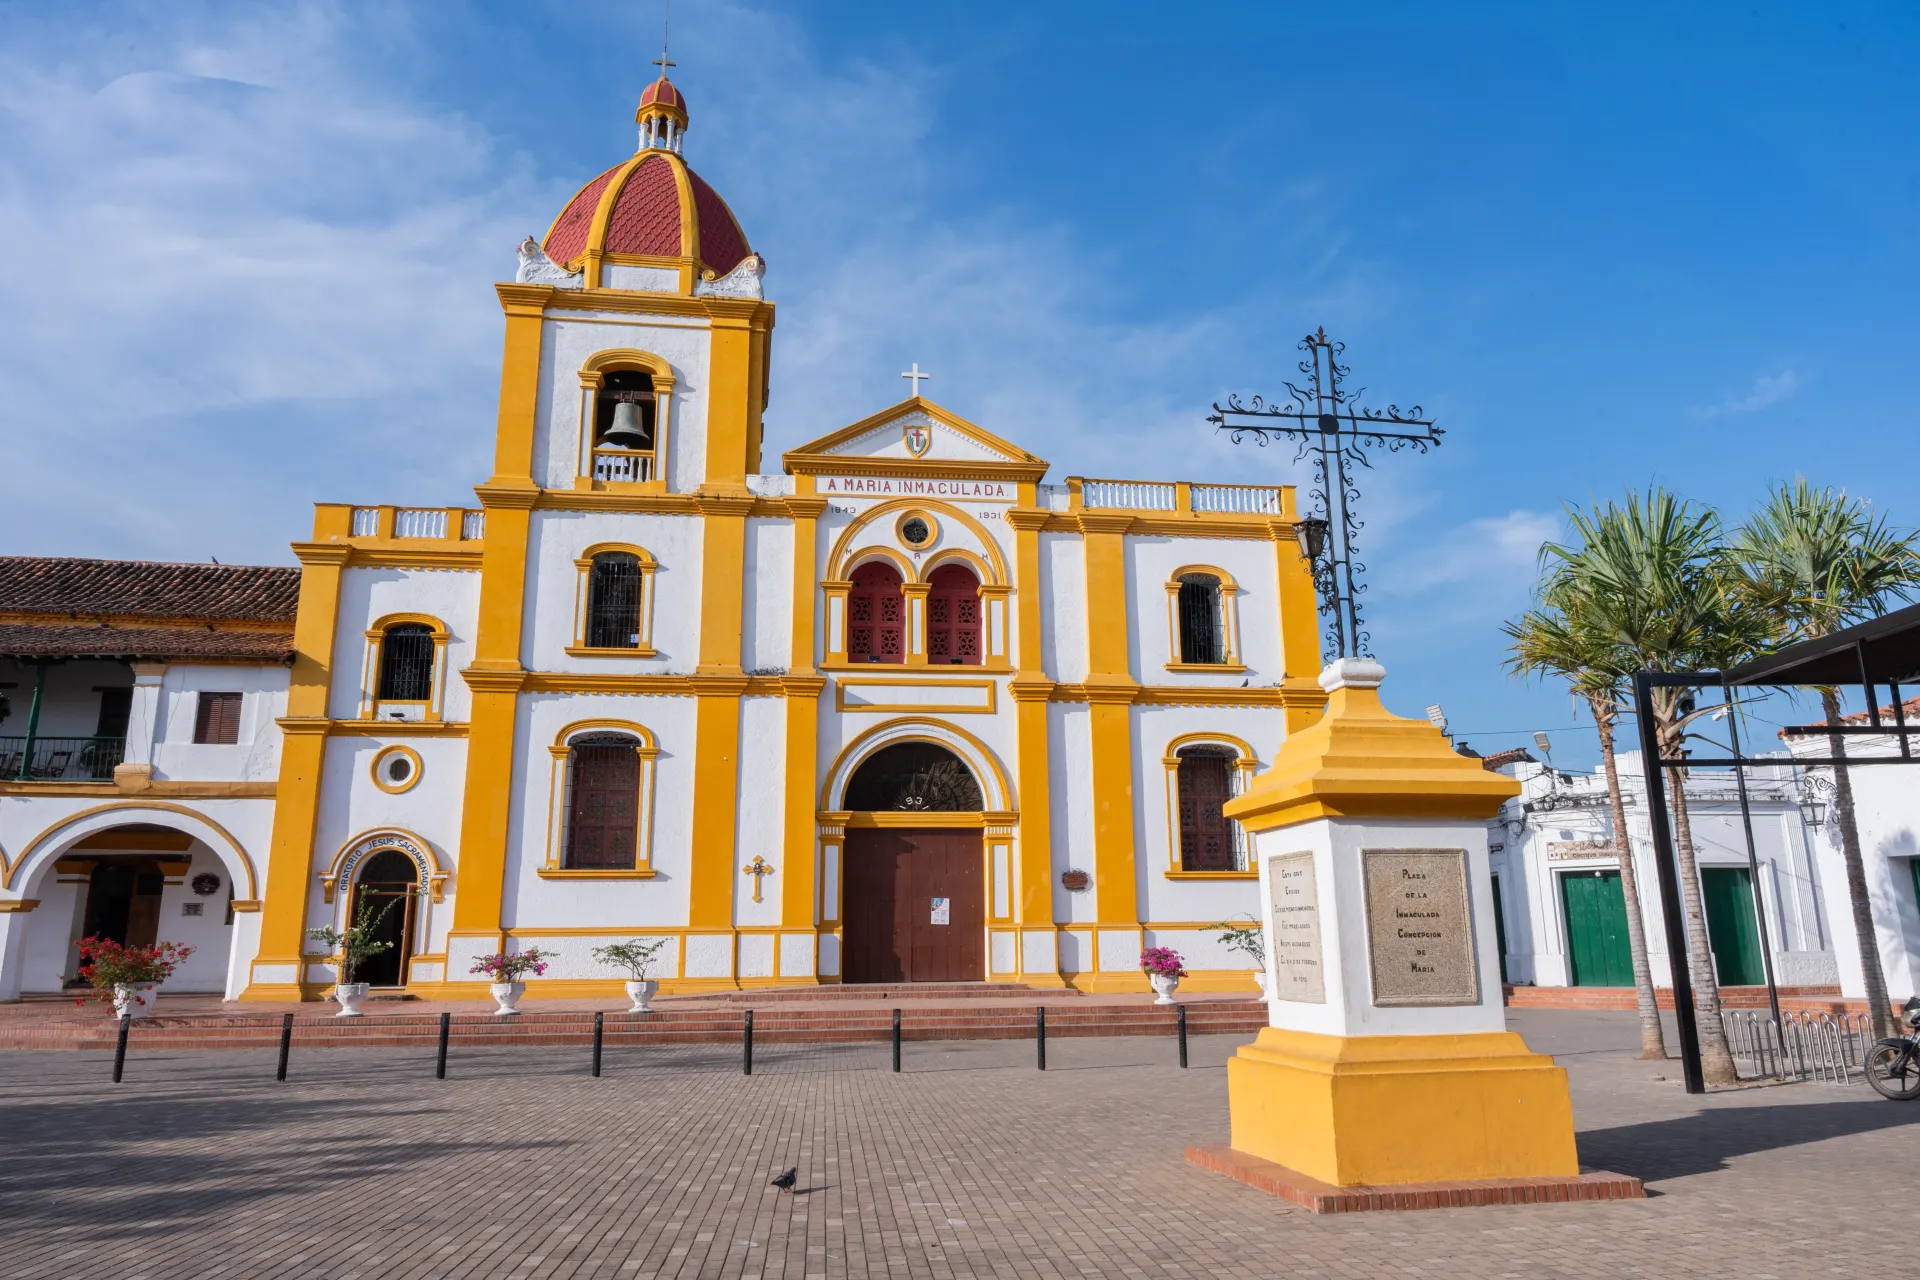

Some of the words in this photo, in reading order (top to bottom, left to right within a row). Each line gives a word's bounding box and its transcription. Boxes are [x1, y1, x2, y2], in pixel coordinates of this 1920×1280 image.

[828, 479, 836, 491] A
[844, 479, 892, 492] MARIA
[831, 506, 856, 514] 1843
[979, 511, 1002, 520] 1931
[340, 849, 362, 891] ORATORIO
[368, 837, 395, 850] JESUS
[1402, 868, 1427, 879] PLAZA
[1395, 907, 1440, 918] INMACULADA
[1397, 928, 1442, 938] CONCEPCION
[1411, 962, 1435, 973] MARIA
